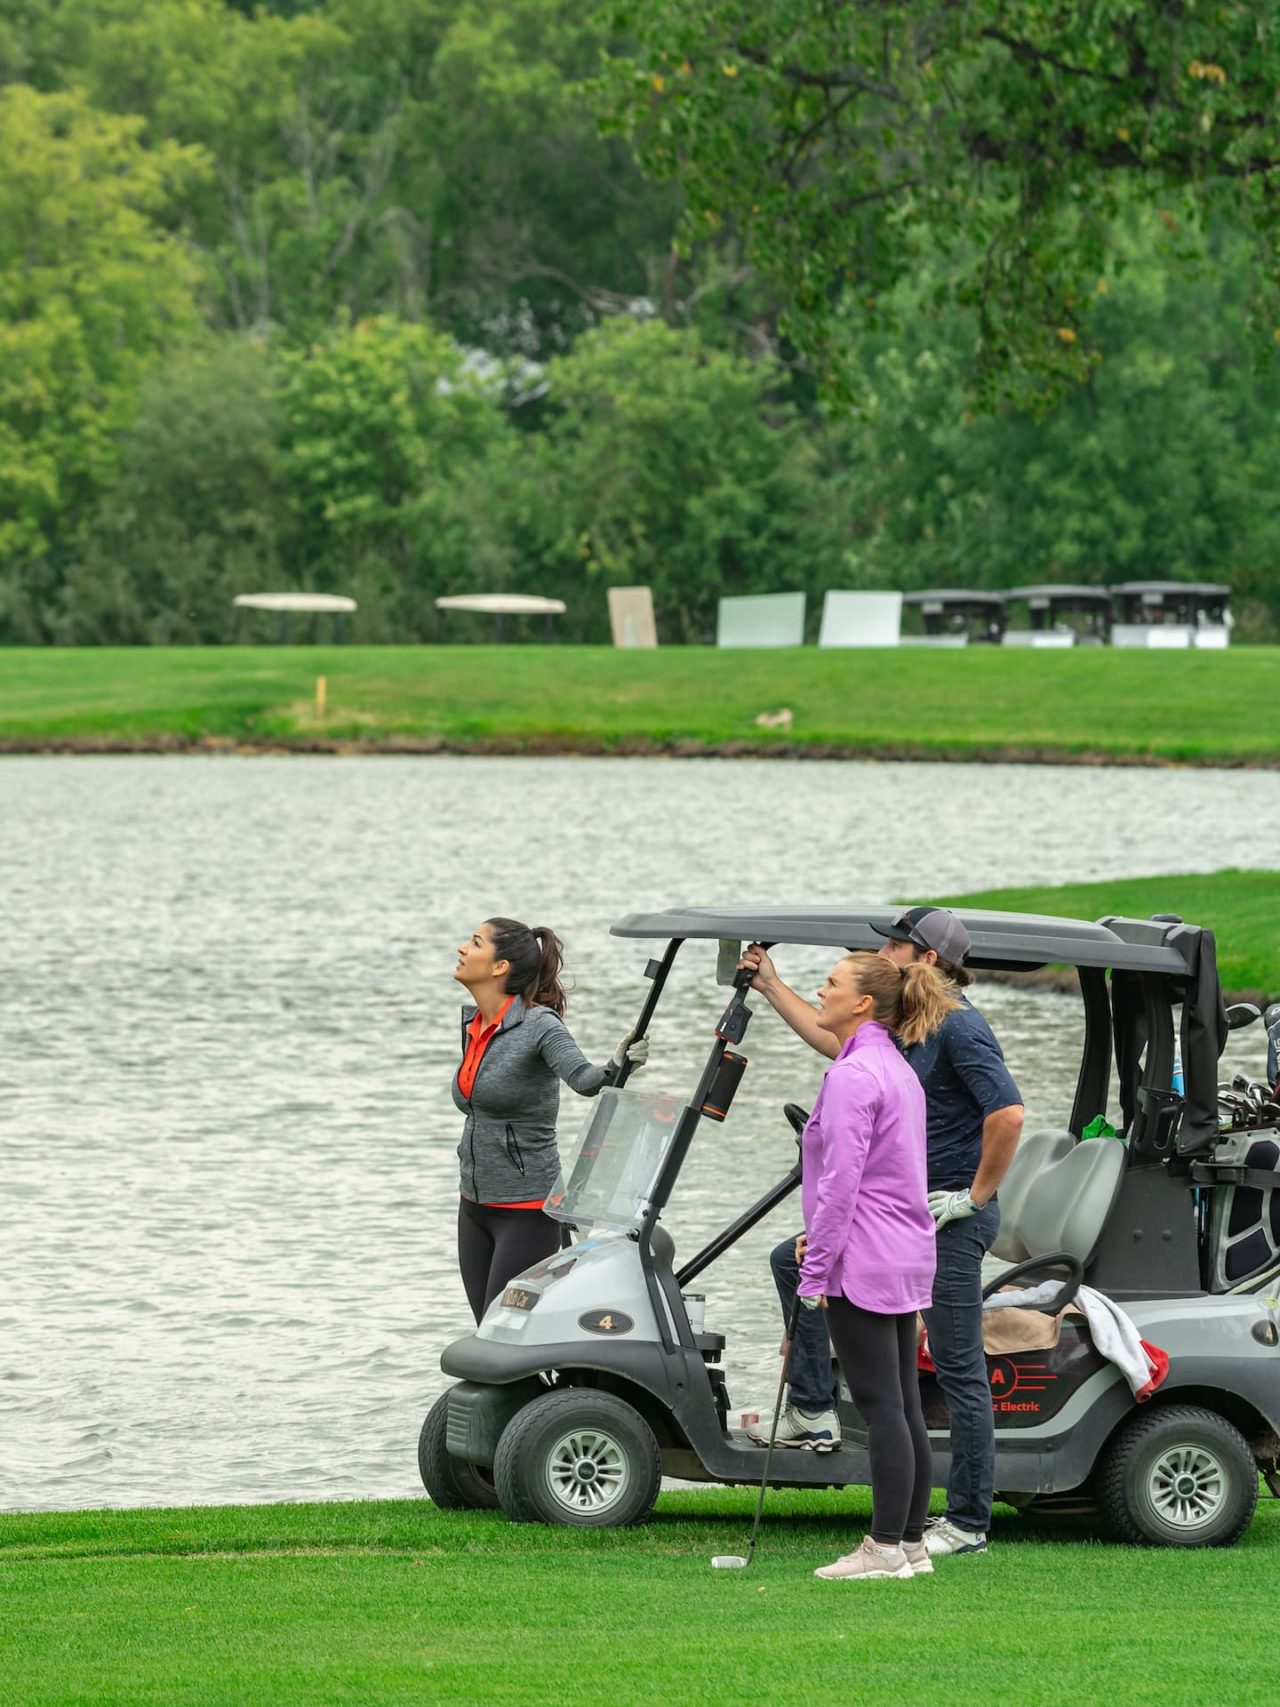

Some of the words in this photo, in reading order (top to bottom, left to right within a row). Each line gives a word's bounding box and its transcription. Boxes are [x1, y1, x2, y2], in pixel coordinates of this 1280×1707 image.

[599, 1315, 612, 1329] 4
[991, 1368, 1005, 1384] A
[1001, 1401, 1040, 1411] Electric
